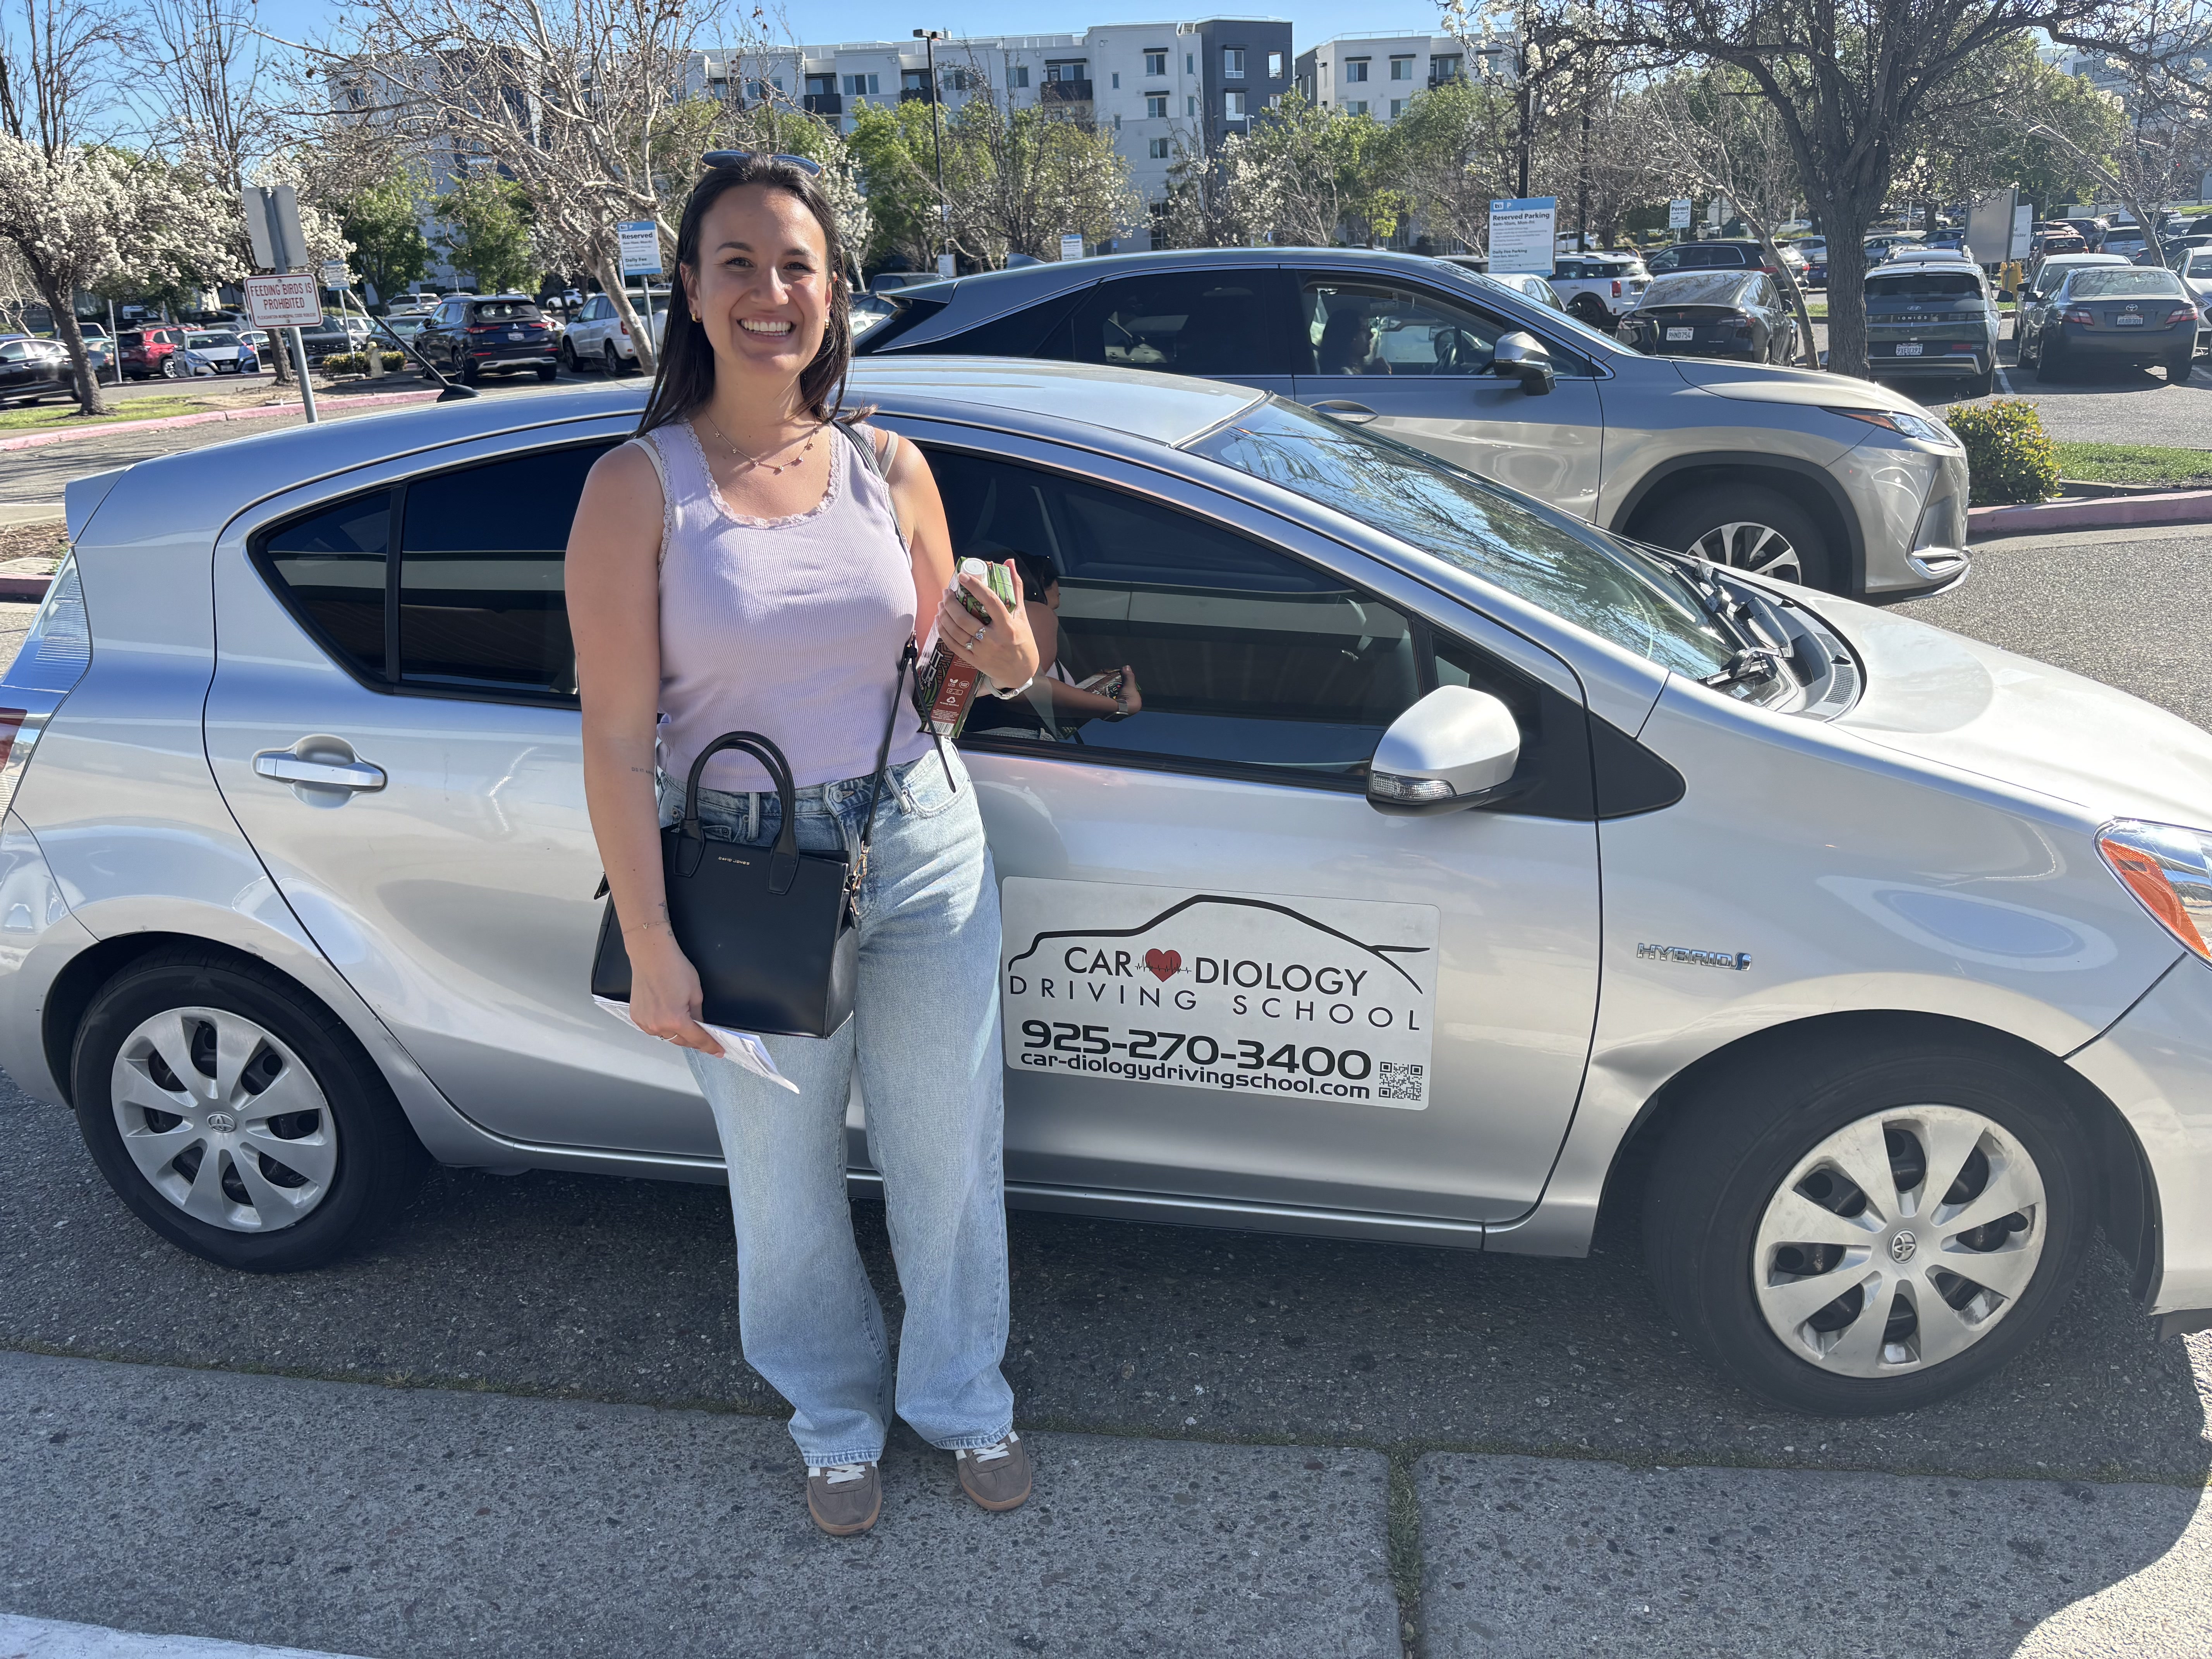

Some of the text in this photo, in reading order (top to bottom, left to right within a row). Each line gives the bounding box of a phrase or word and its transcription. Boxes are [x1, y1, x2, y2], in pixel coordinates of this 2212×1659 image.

[250, 282, 313, 297] FEEDING BIRDS IS
[263, 297, 305, 310] PROHIBITED
[1064, 946, 1368, 996] CAR DIOLOGY
[1637, 943, 1732, 969] HYBRID
[1010, 975, 1420, 1031] DRIVING SCHOOL
[1021, 1019, 1372, 1080] 925-270-3400
[1020, 1053, 1370, 1099] car-diologydrivingschool.com
